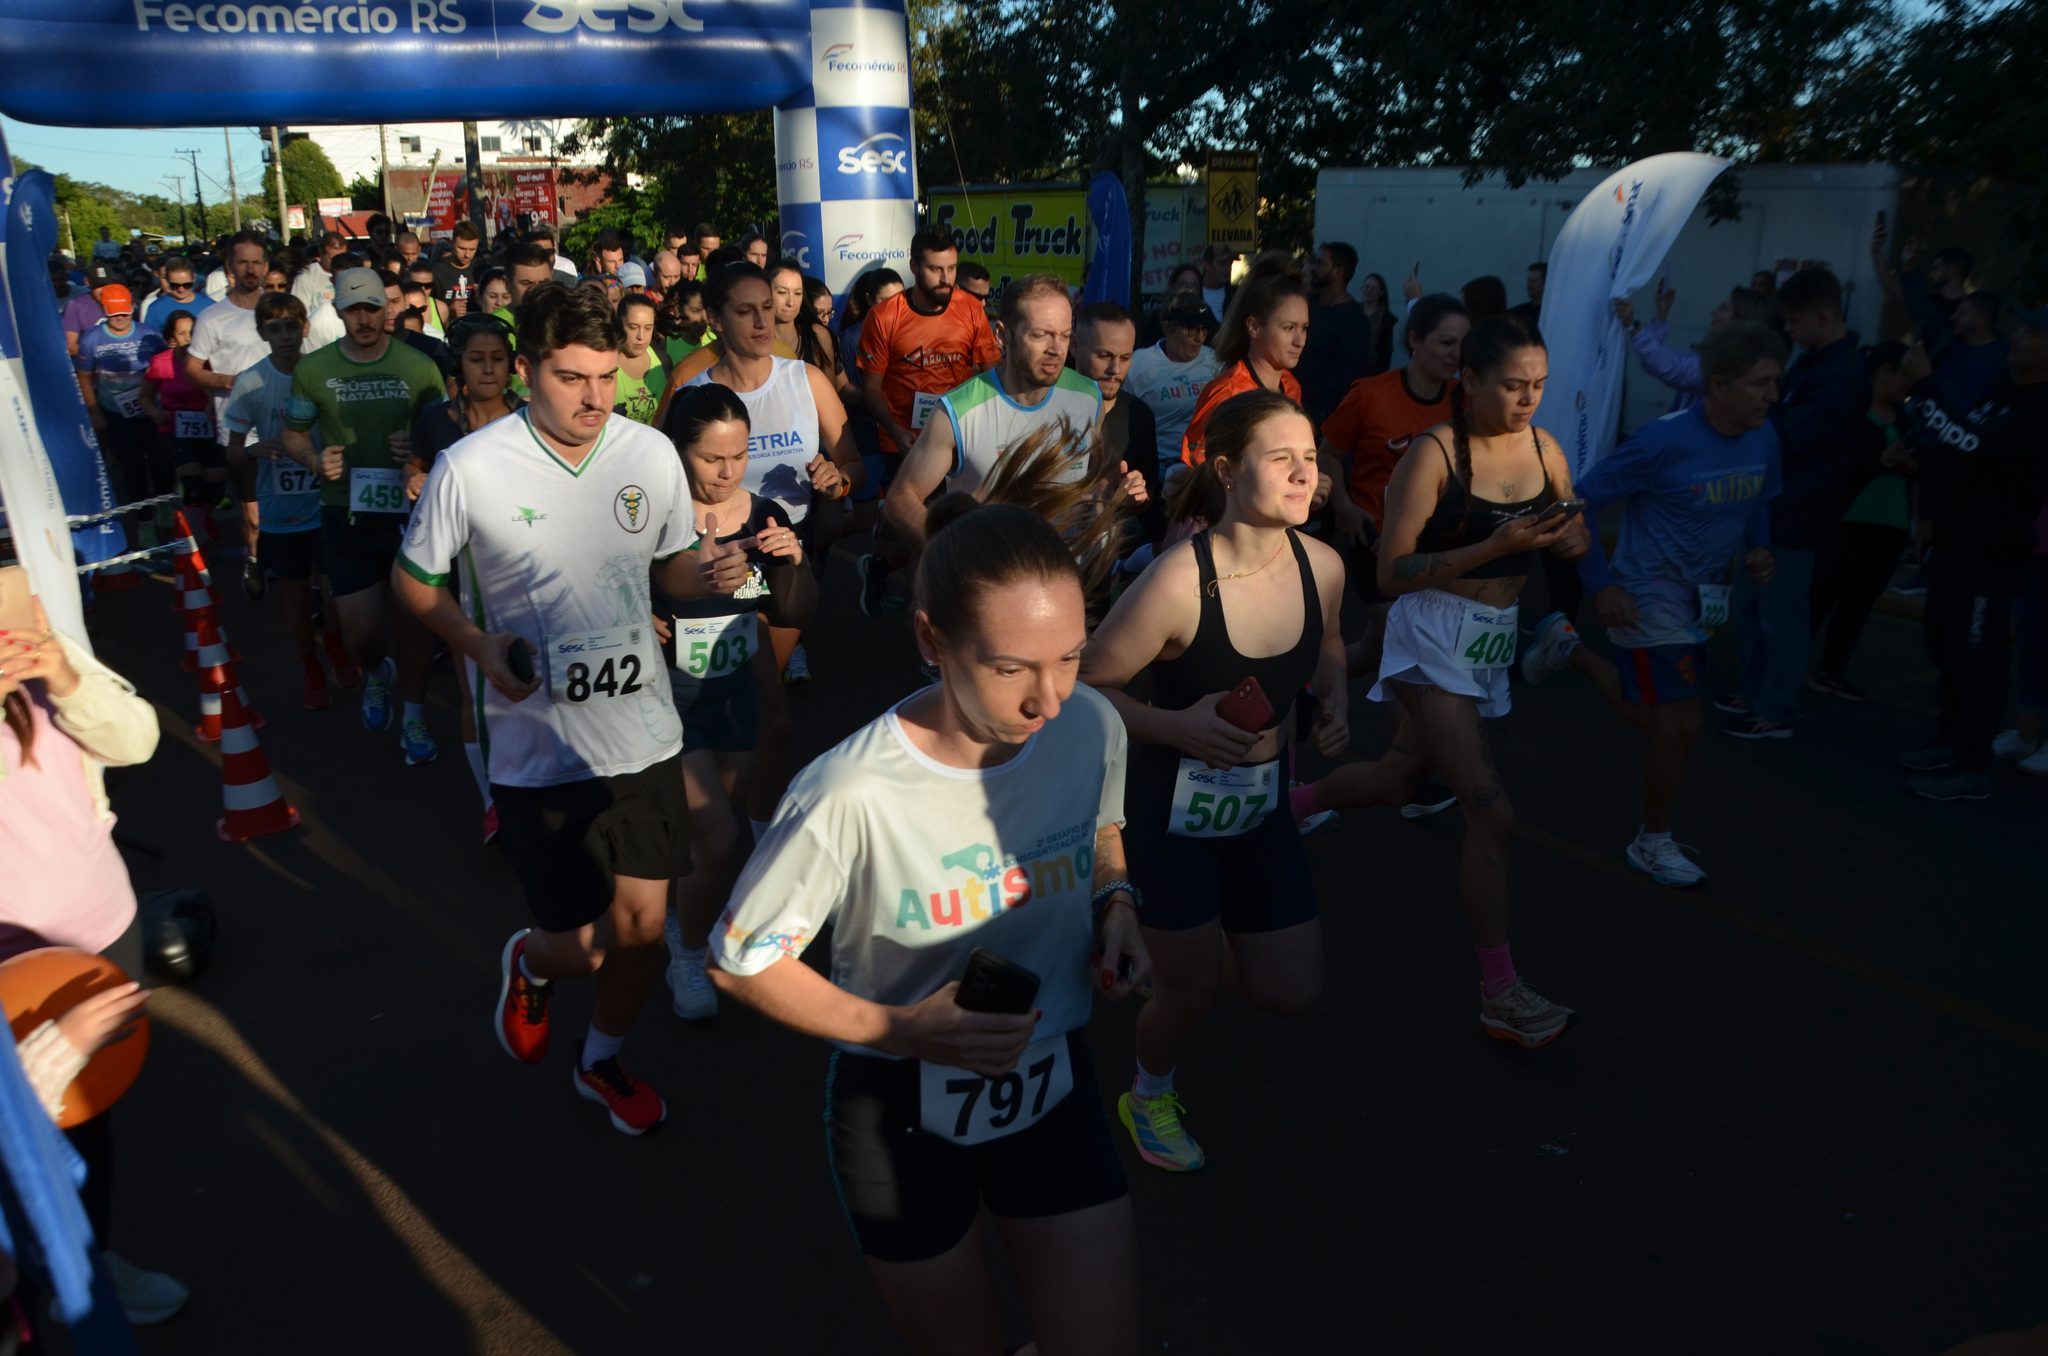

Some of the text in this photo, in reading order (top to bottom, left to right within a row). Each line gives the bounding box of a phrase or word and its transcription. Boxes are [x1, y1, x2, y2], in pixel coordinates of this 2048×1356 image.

[134, 0, 466, 33] Fecomércio RS
[828, 60, 896, 73] Fecomércio
[838, 146, 907, 175] Sesc
[1141, 201, 1181, 223] ruck
[937, 204, 1082, 255] Food Truck
[1211, 228, 1253, 241] ELEVADA
[840, 249, 905, 261] Fecomércio
[335, 379, 410, 393] RÚSTICA
[335, 390, 411, 403] NATALINA
[181, 420, 209, 436] 751
[280, 469, 320, 492] 672
[358, 484, 404, 509] 459
[558, 643, 586, 654] Sesc
[688, 635, 749, 674] 503
[1464, 631, 1516, 665] 408
[566, 654, 643, 703] 842
[1188, 771, 1217, 785] Sesc
[1185, 791, 1268, 833] 507
[896, 844, 1092, 930] Autismo
[946, 1052, 1055, 1137] 797
